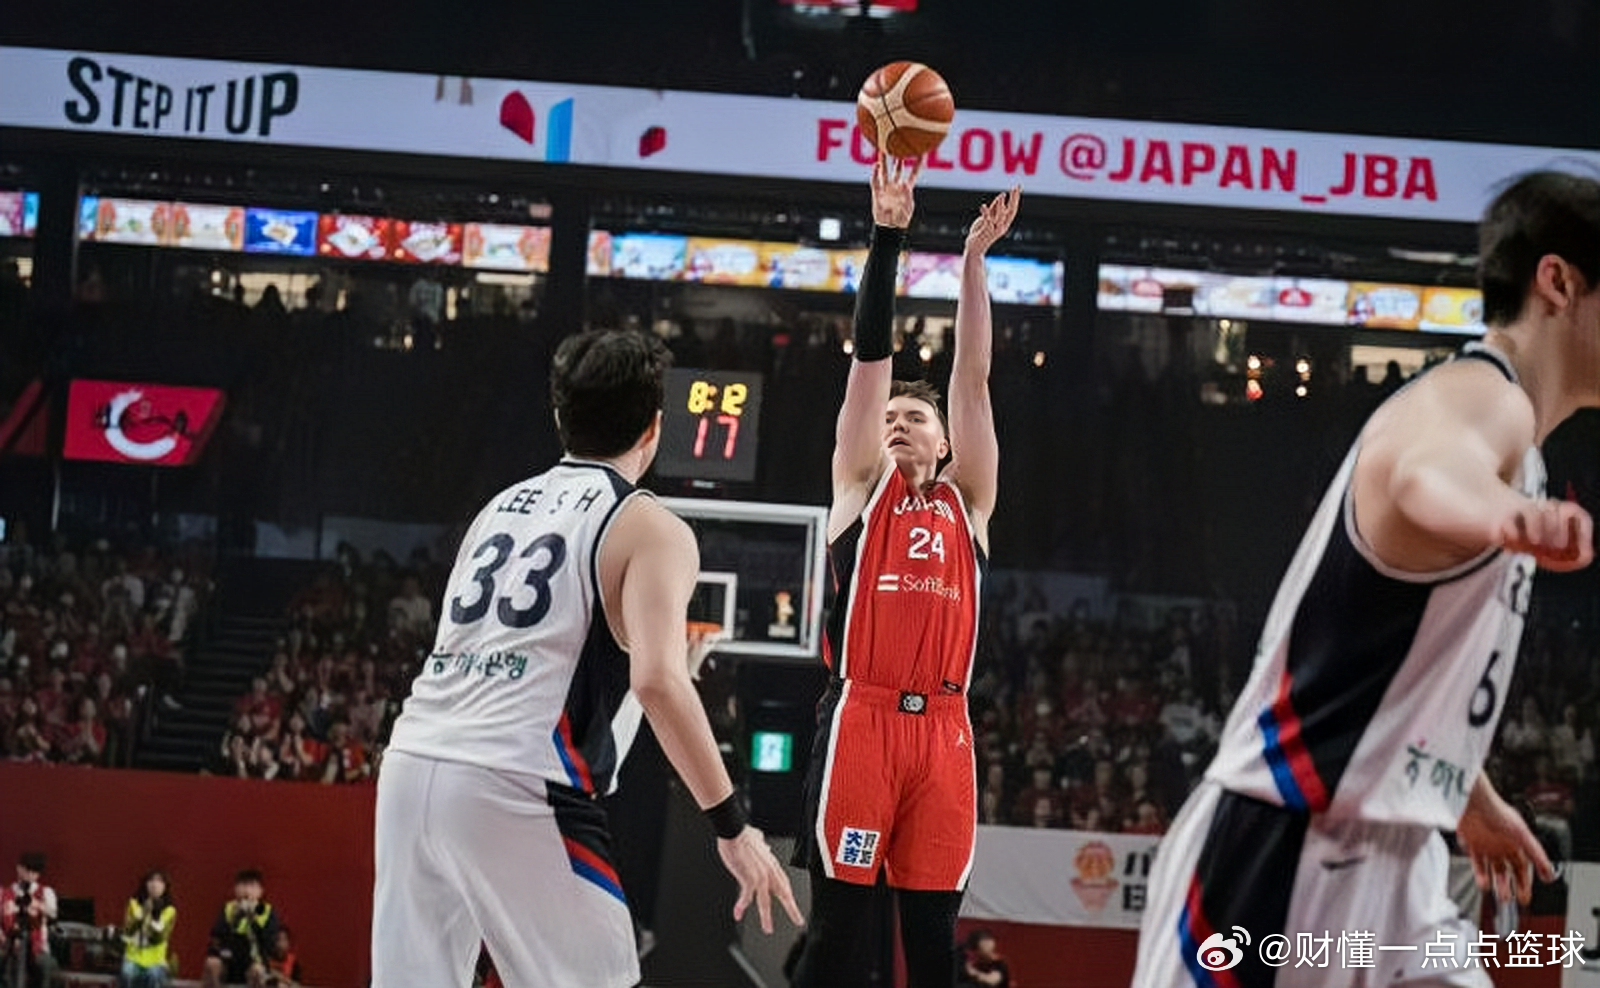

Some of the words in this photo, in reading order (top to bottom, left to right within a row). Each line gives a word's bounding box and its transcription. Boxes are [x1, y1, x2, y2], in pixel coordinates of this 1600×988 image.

[64, 56, 173, 130] STEP
[184, 84, 215, 132] IT
[225, 71, 298, 137] UP
[816, 118, 1043, 176] FOLOW
[1058, 132, 1438, 203] @JAPAN_JBA
[693, 414, 739, 458] 17
[574, 487, 602, 512] H
[450, 532, 566, 628] 33
[908, 526, 945, 564] 24
[1468, 650, 1499, 728] 6
